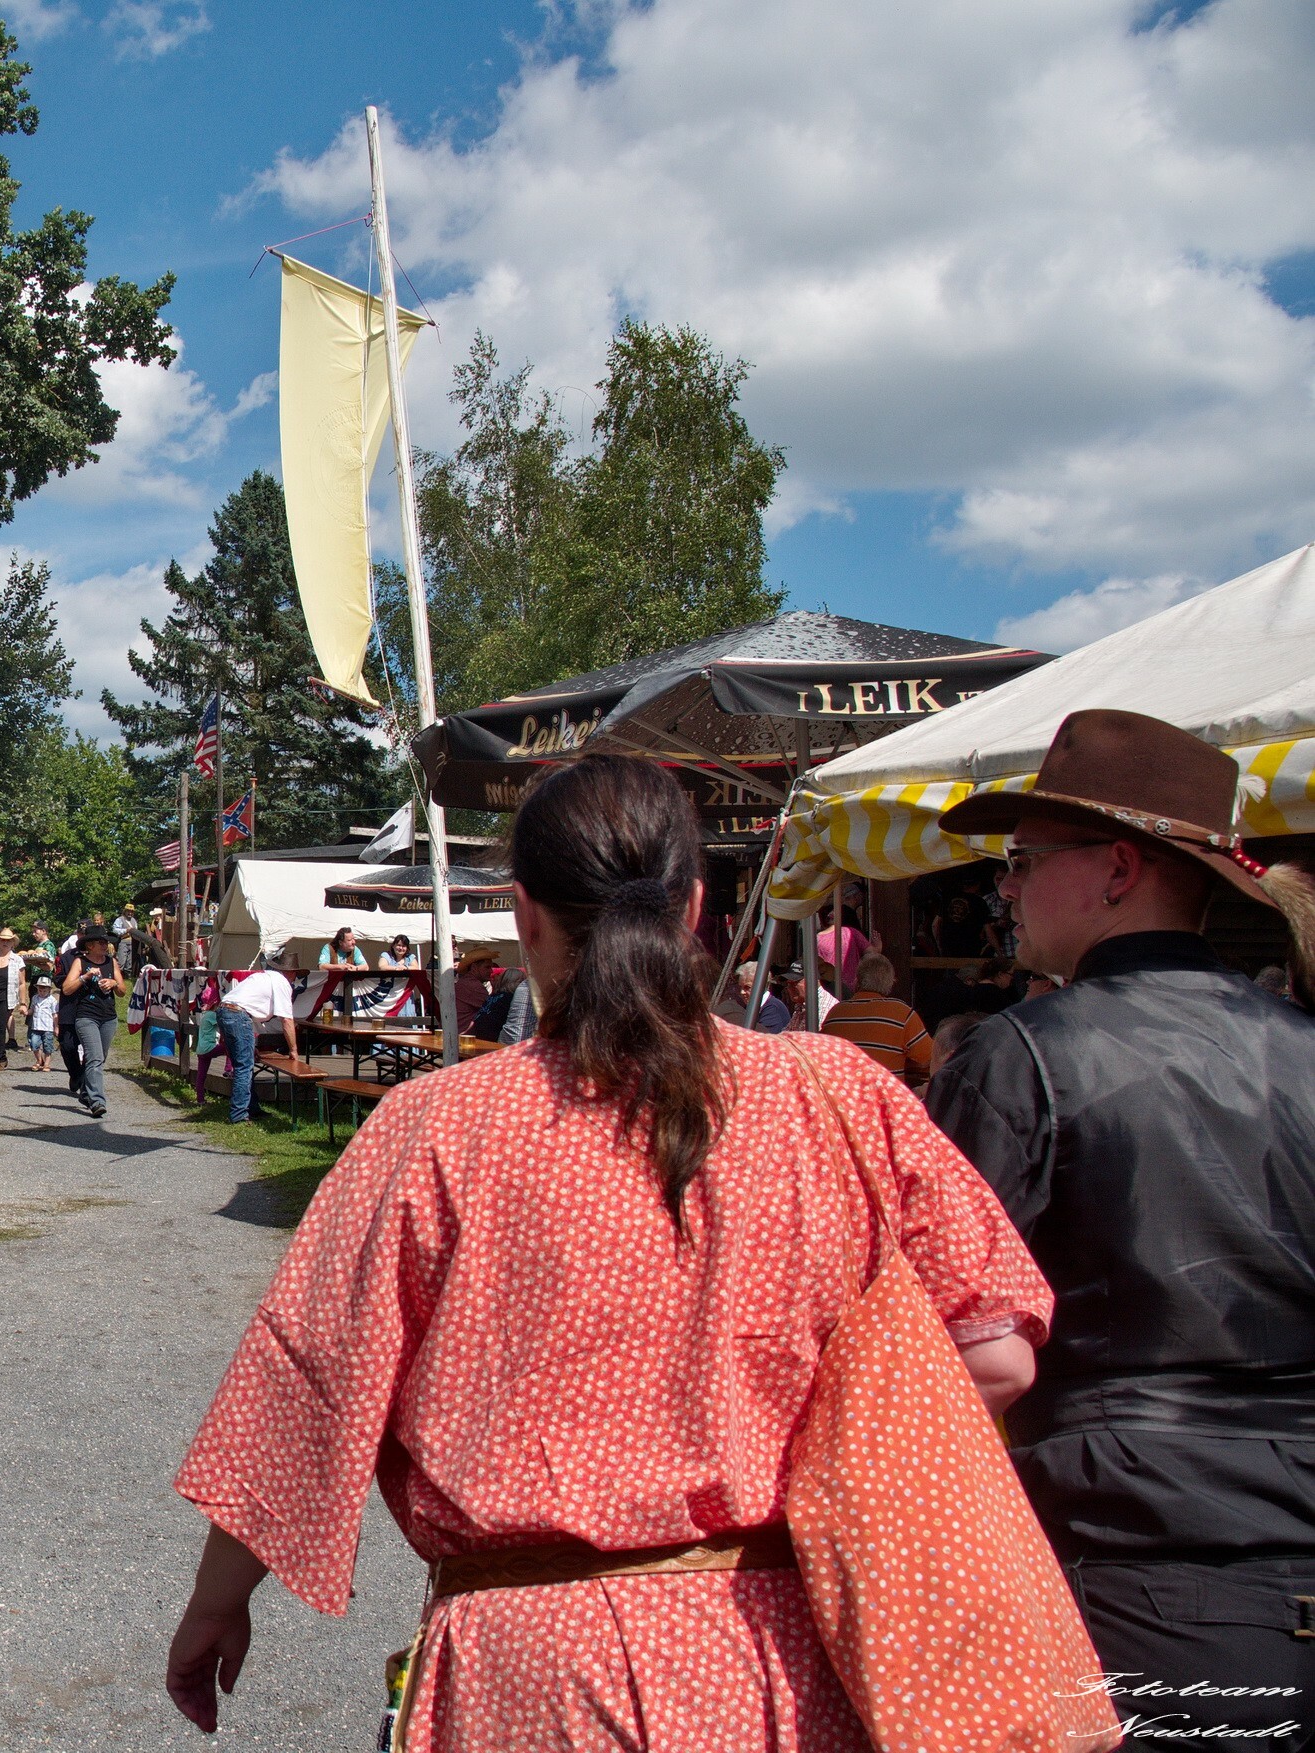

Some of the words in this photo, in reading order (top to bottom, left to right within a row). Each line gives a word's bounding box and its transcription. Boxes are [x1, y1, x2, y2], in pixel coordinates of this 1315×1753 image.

[797, 692, 810, 713] I
[813, 678, 952, 714] LEIK
[506, 706, 603, 758] Leikei
[397, 896, 434, 911] Leikei
[484, 897, 513, 910] LEIK
